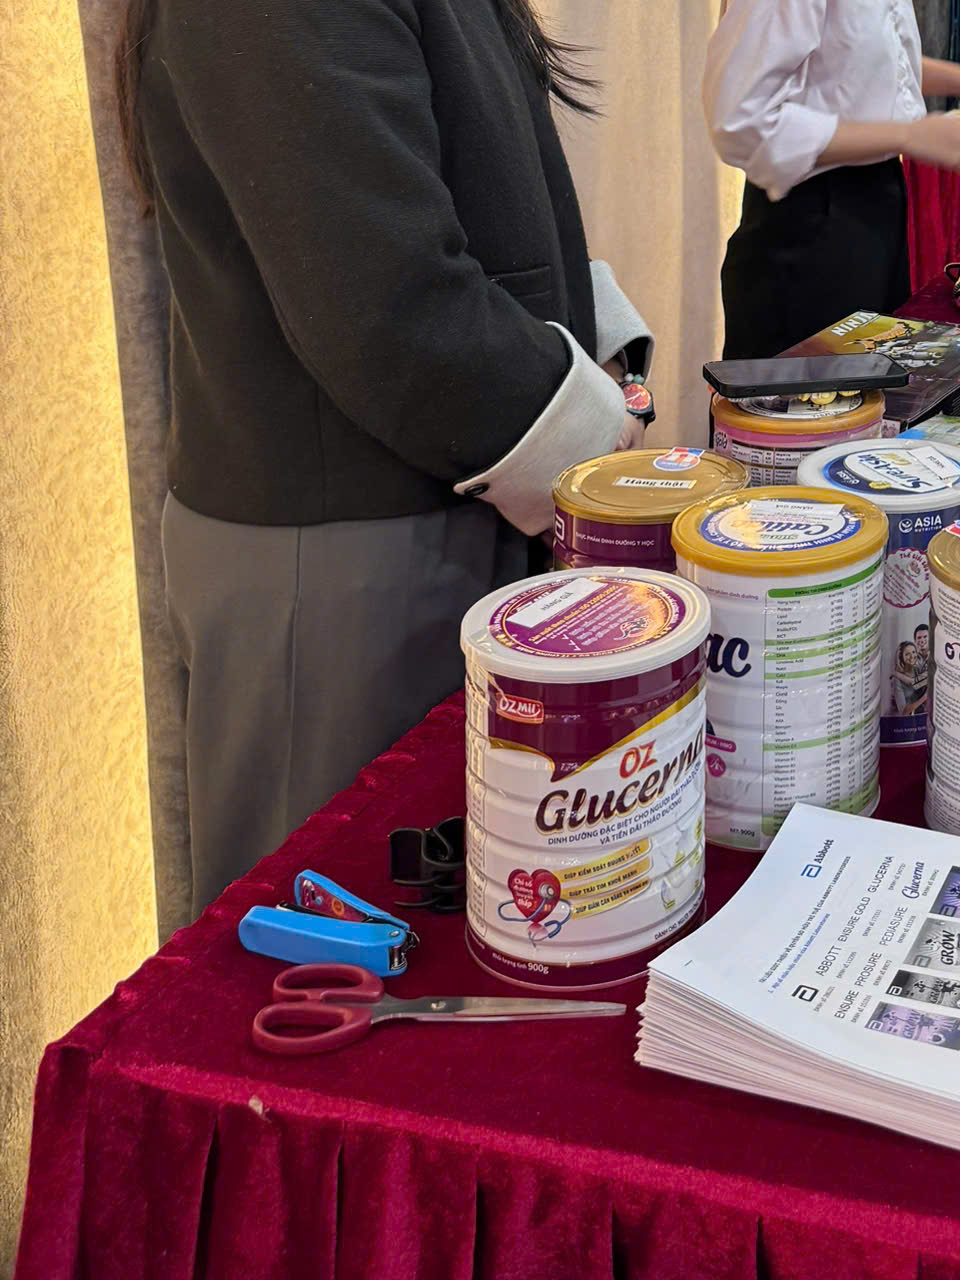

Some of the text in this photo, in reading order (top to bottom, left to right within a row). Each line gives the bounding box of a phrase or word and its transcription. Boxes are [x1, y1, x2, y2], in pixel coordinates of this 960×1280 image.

[914, 515, 942, 528] ASIA
[619, 739, 656, 778] OZ
[548, 837, 568, 846] DINH
[569, 830, 598, 842] DƯỠNG
[600, 824, 616, 836] ĐẶC
[617, 818, 633, 831] BIỆT
[633, 811, 649, 823] CHO
[813, 839, 834, 864] Abbott
[867, 856, 894, 893] GLUCERNA
[901, 861, 925, 899] Glucerna
[854, 896, 871, 916] GOLD
[837, 915, 861, 942] ENSURE
[879, 907, 908, 946] PEDIASURE
[815, 945, 842, 976] ABBOTT
[940, 930, 955, 966] GROW
[527, 962, 549, 974] 900g
[854, 952, 882, 987] PROSURE
[834, 989, 859, 1019] ENSURE
[929, 978, 944, 1004] GROW
[902, 1009, 920, 1039] GROW
